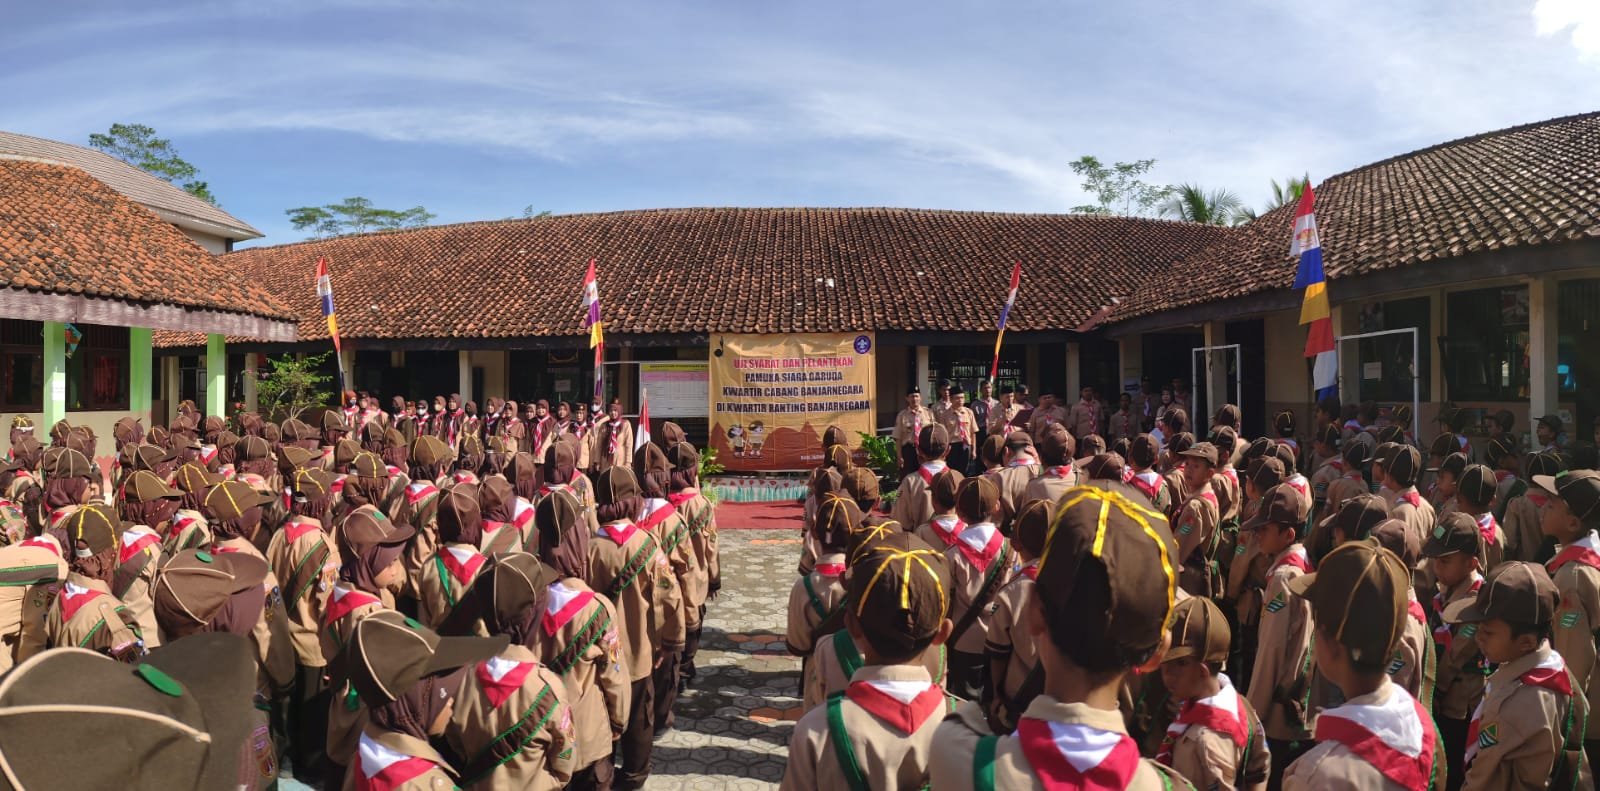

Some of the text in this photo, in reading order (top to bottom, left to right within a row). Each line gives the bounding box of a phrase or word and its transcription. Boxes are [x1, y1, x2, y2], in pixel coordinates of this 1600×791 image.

[749, 359, 779, 369] SYARAT
[783, 359, 800, 368] DAN
[803, 357, 853, 368] PELANTIKAN
[782, 372, 807, 382] SIAGA
[809, 371, 843, 381] GARUDA
[723, 385, 864, 397] KWARTIR CABANG BANJARNEGARA
[716, 400, 870, 413] DI KWARTIR RANTING BANJARNEGARA
